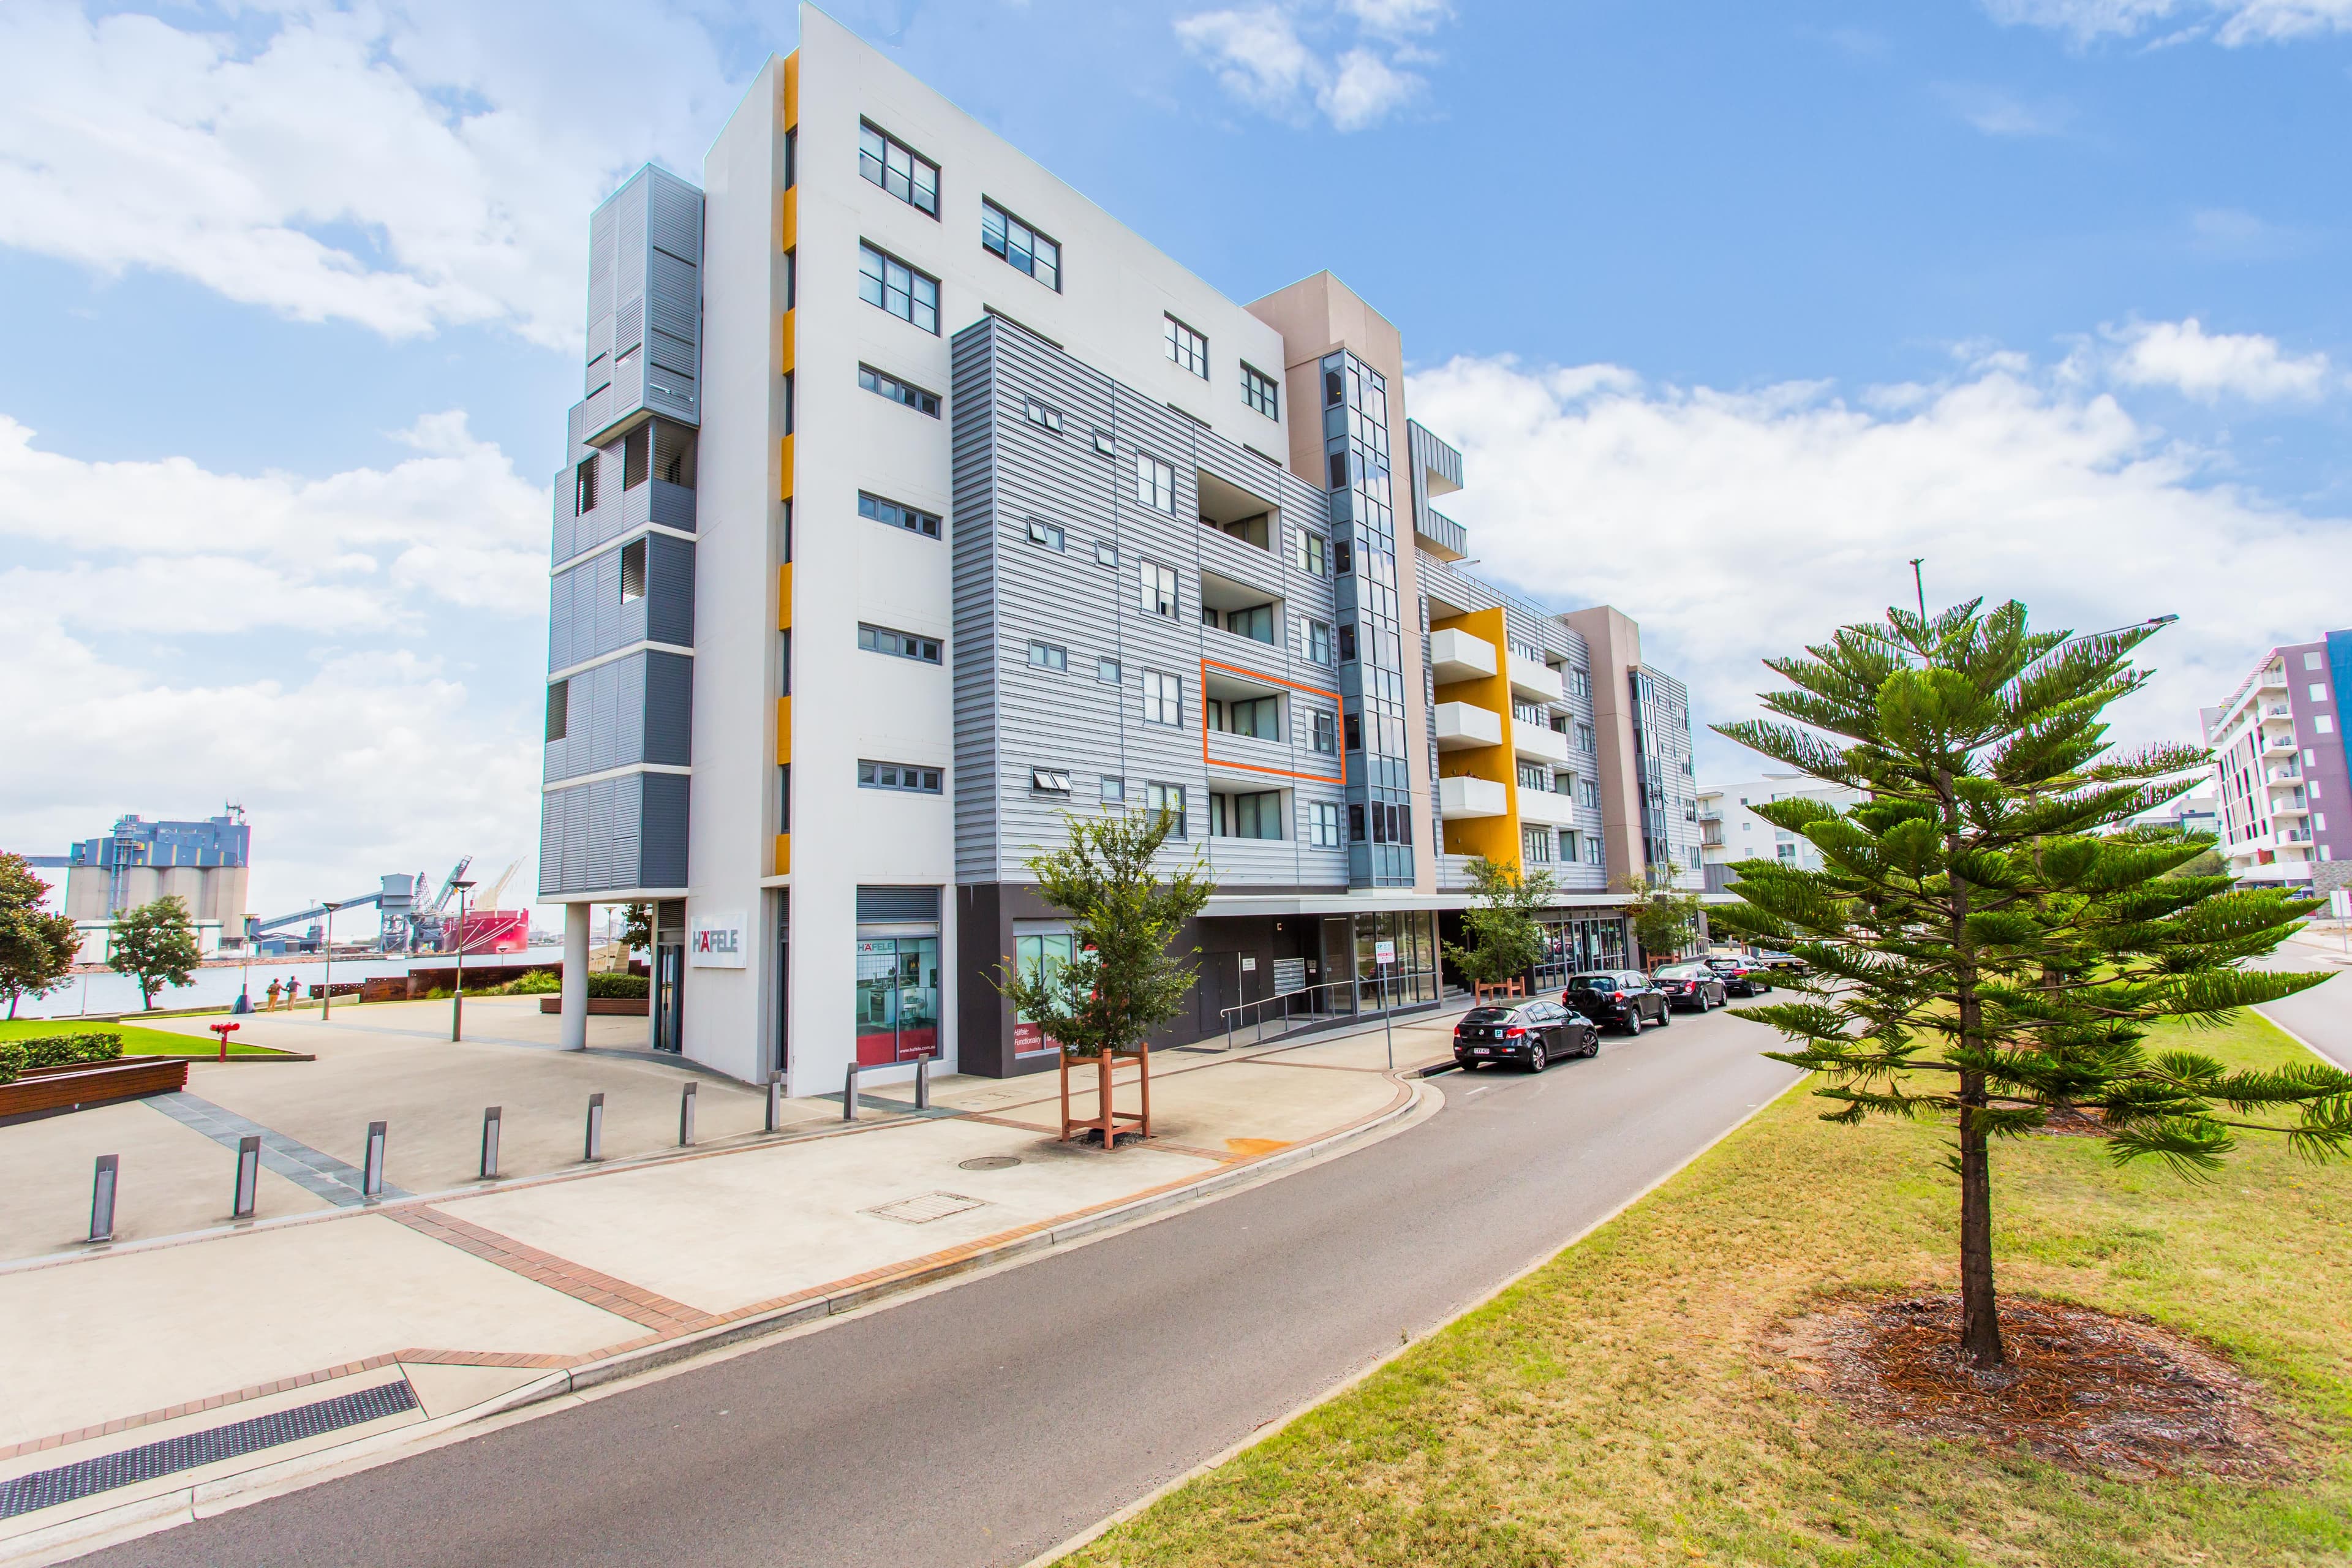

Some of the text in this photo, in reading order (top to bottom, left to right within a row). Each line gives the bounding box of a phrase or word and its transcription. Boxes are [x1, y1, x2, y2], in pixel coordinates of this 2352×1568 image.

[693, 929, 739, 952] HÄFELE
[858, 943, 892, 951] HÄFELE
[1014, 1036, 1041, 1046] Functionality
